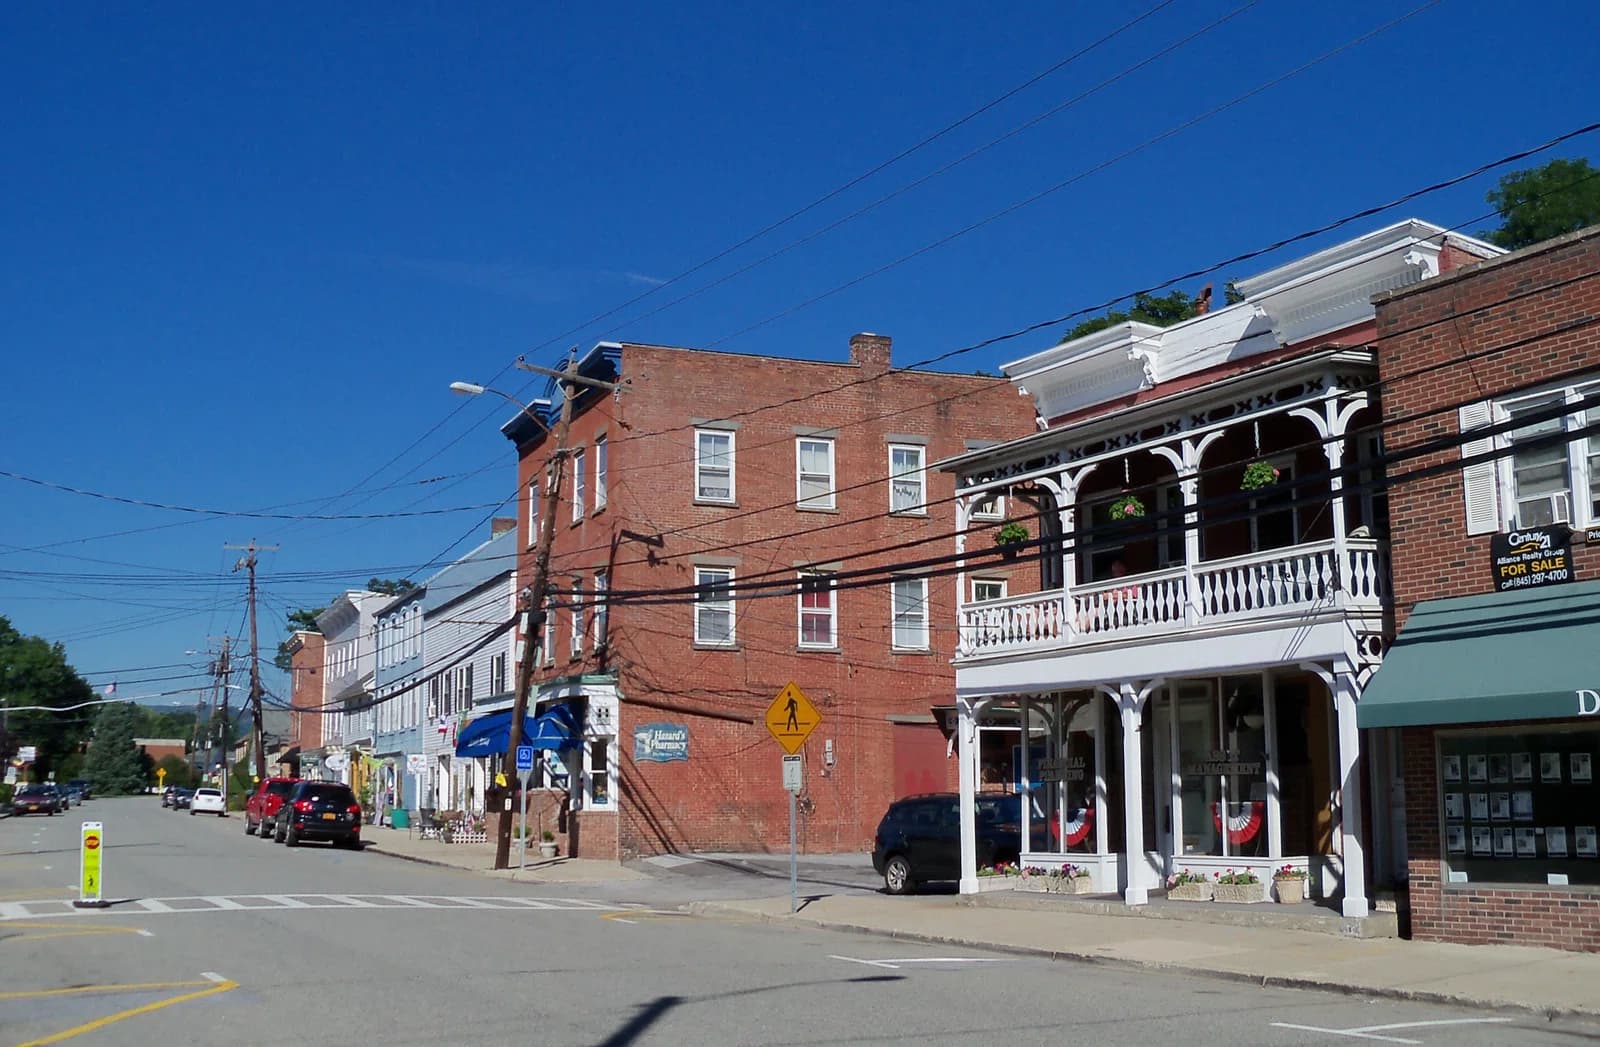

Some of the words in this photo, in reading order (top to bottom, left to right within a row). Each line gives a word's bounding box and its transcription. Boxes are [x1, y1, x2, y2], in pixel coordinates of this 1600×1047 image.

[1508, 532, 1543, 546] Century
[1540, 535, 1551, 549] 21
[1497, 555, 1521, 565] Alliance
[1501, 563, 1527, 577] FOR
[1532, 557, 1565, 572] SALE
[1532, 569, 1568, 584] 297-4700
